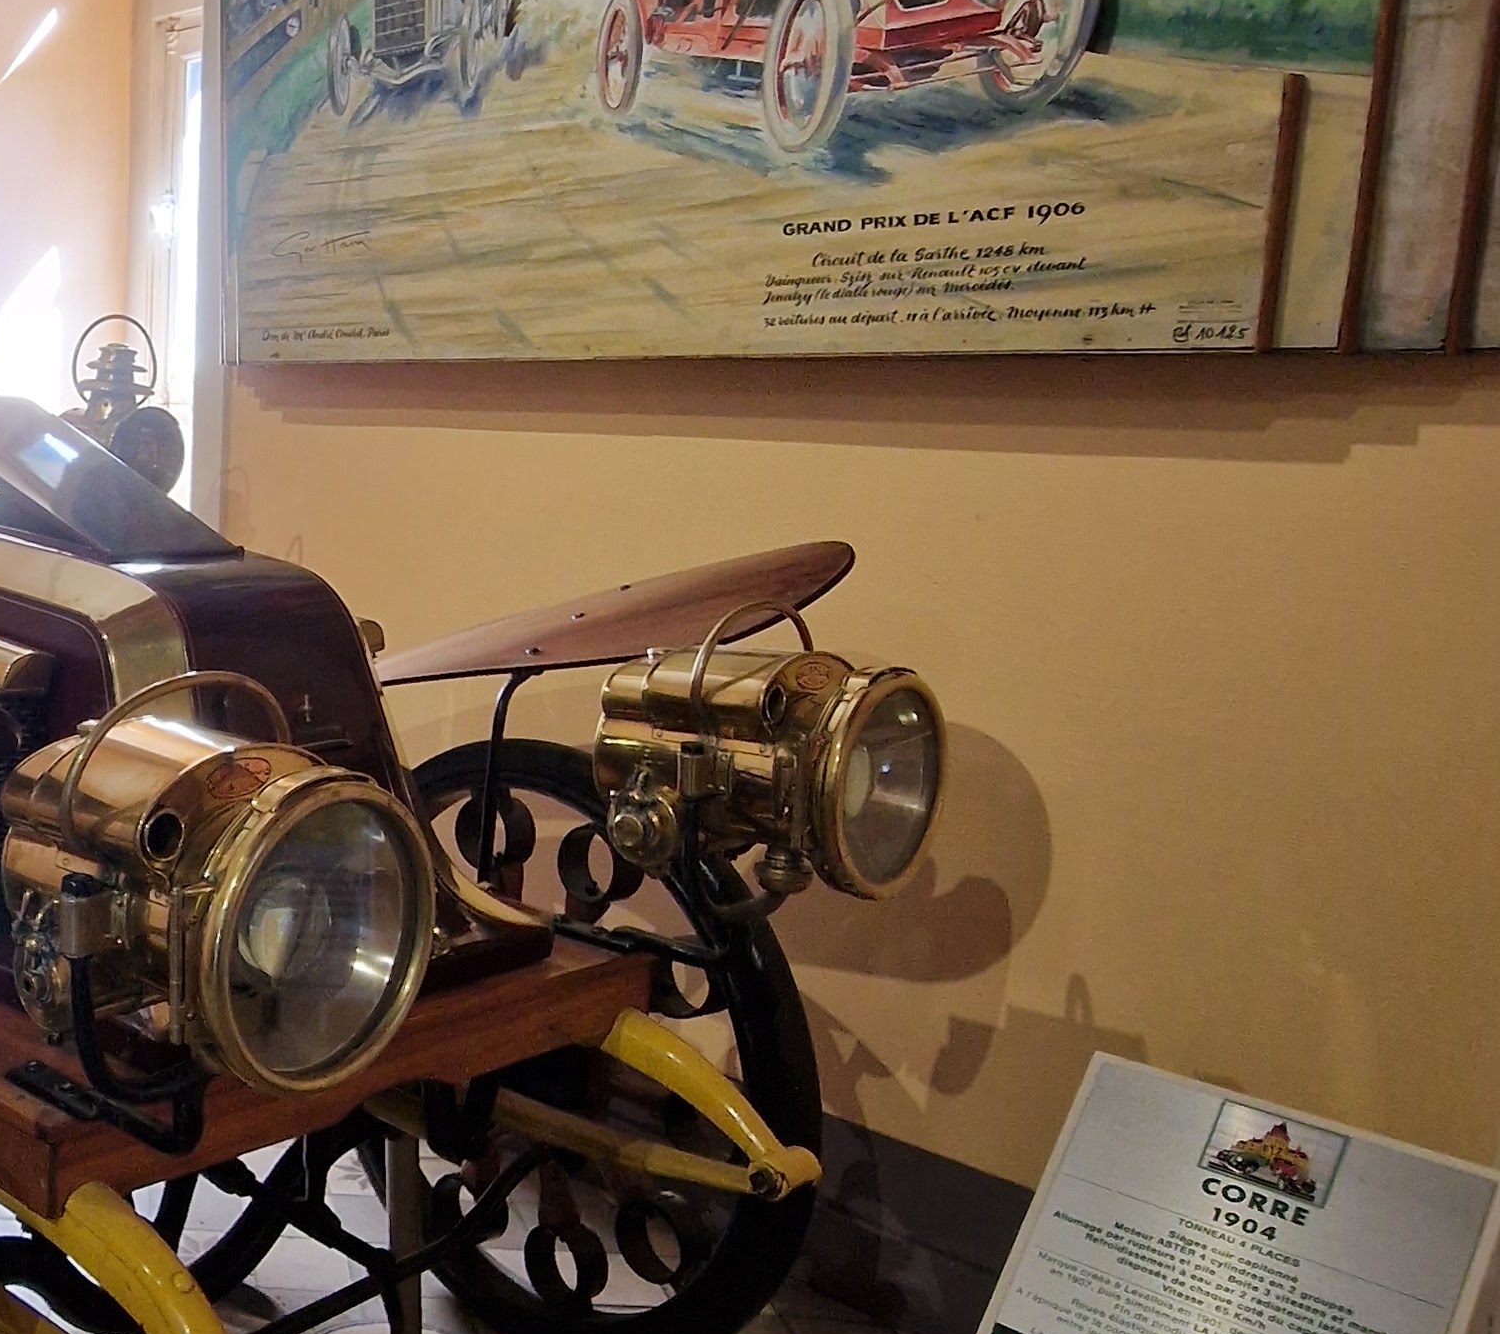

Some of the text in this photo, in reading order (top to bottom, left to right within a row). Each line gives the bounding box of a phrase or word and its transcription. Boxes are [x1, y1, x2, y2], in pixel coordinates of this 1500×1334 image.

[782, 201, 1086, 237] GRAND PRIX DE L'ACF 1906
[812, 252, 866, 267] Circuit
[867, 250, 885, 264] de
[890, 248, 908, 263] la
[913, 245, 970, 262] Sarthe
[975, 245, 1015, 259] 1248
[879, 270, 903, 282] sur
[910, 264, 976, 279] Renault
[1025, 257, 1088, 272] devant
[778, 314, 826, 327] voitures
[828, 315, 849, 325] au
[1201, 1176, 1310, 1226] CORRE
[1212, 1206, 1279, 1241] 1904
[1113, 1220, 1154, 1241] Moteur
[1156, 1236, 1196, 1257] ASTER
[1208, 1256, 1265, 1284] cylindres
[1267, 1277, 1284, 1290] en
[1177, 1217, 1301, 1268] TONNEAU 4 PLACES
[1210, 1244, 1235, 1259] cuir
[1084, 1231, 1176, 1272] Refroidissement
[1189, 1271, 1212, 1286] eau
[1249, 1293, 1315, 1325] radiateurs
[1160, 1283, 1205, 1306] Vitesse
[1213, 1303, 1230, 1316] 65
